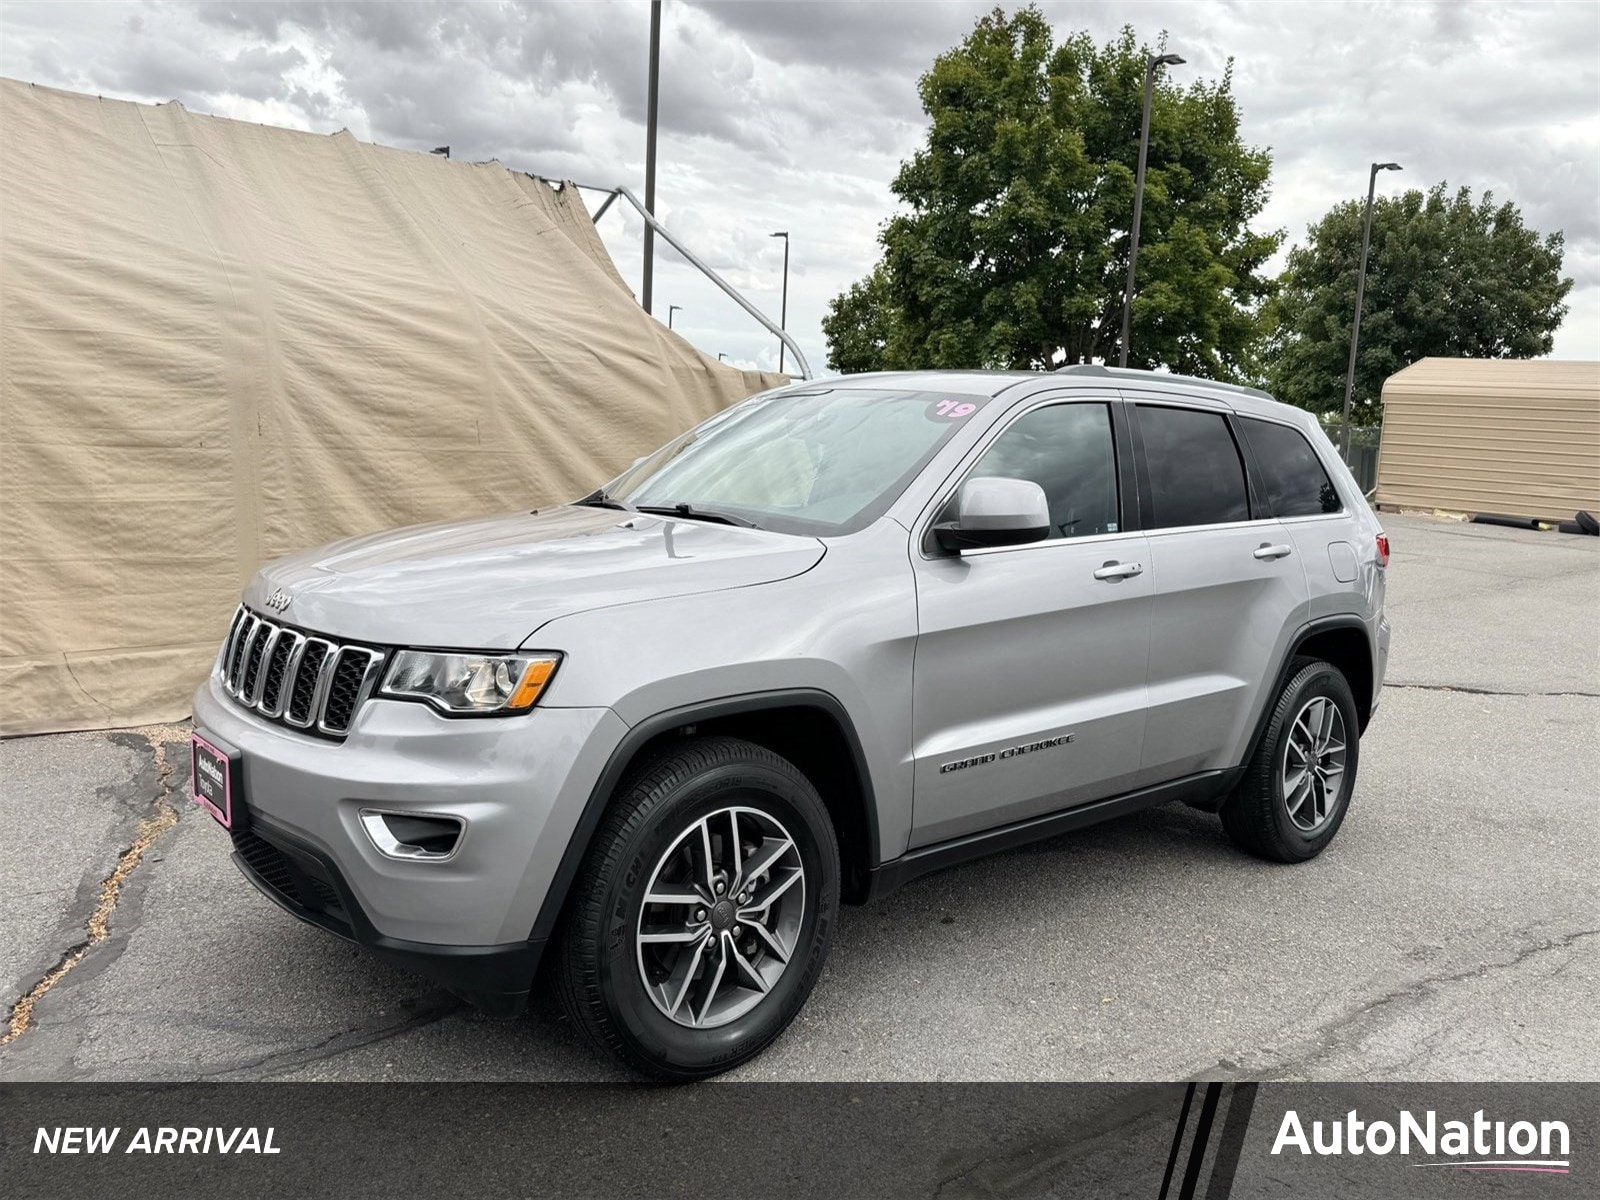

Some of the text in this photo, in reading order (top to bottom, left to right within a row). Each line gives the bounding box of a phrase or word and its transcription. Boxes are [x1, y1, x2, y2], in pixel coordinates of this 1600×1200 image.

[265, 587, 292, 615] Jeep
[939, 732, 1076, 774] GRAND CHEROKEE
